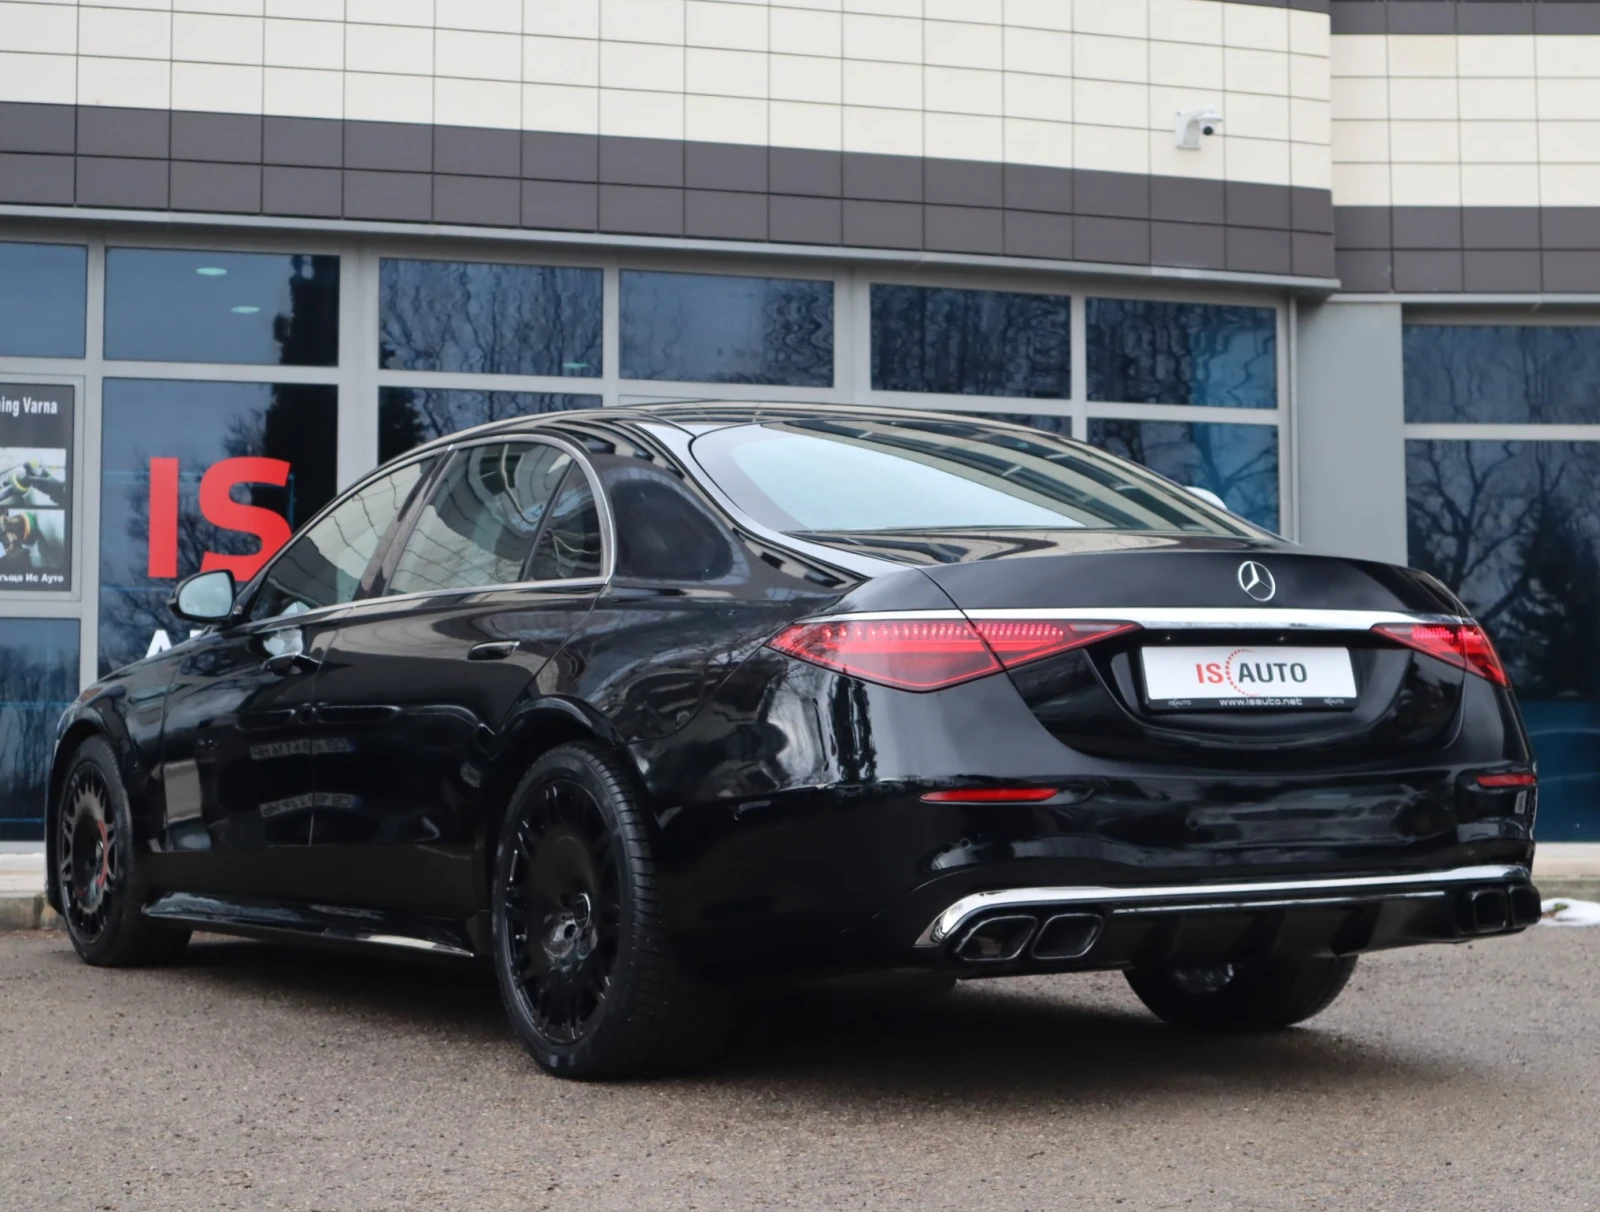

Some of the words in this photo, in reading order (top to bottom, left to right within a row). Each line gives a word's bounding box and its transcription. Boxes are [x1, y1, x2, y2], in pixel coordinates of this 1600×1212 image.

[0, 396, 20, 417] ing
[23, 396, 58, 414] Varna
[148, 456, 293, 582] IS
[41, 573, 64, 584] Ауто
[1196, 663, 1224, 684] IS
[1238, 662, 1308, 683] AUTO
[1219, 697, 1303, 706] www.isauto.net
